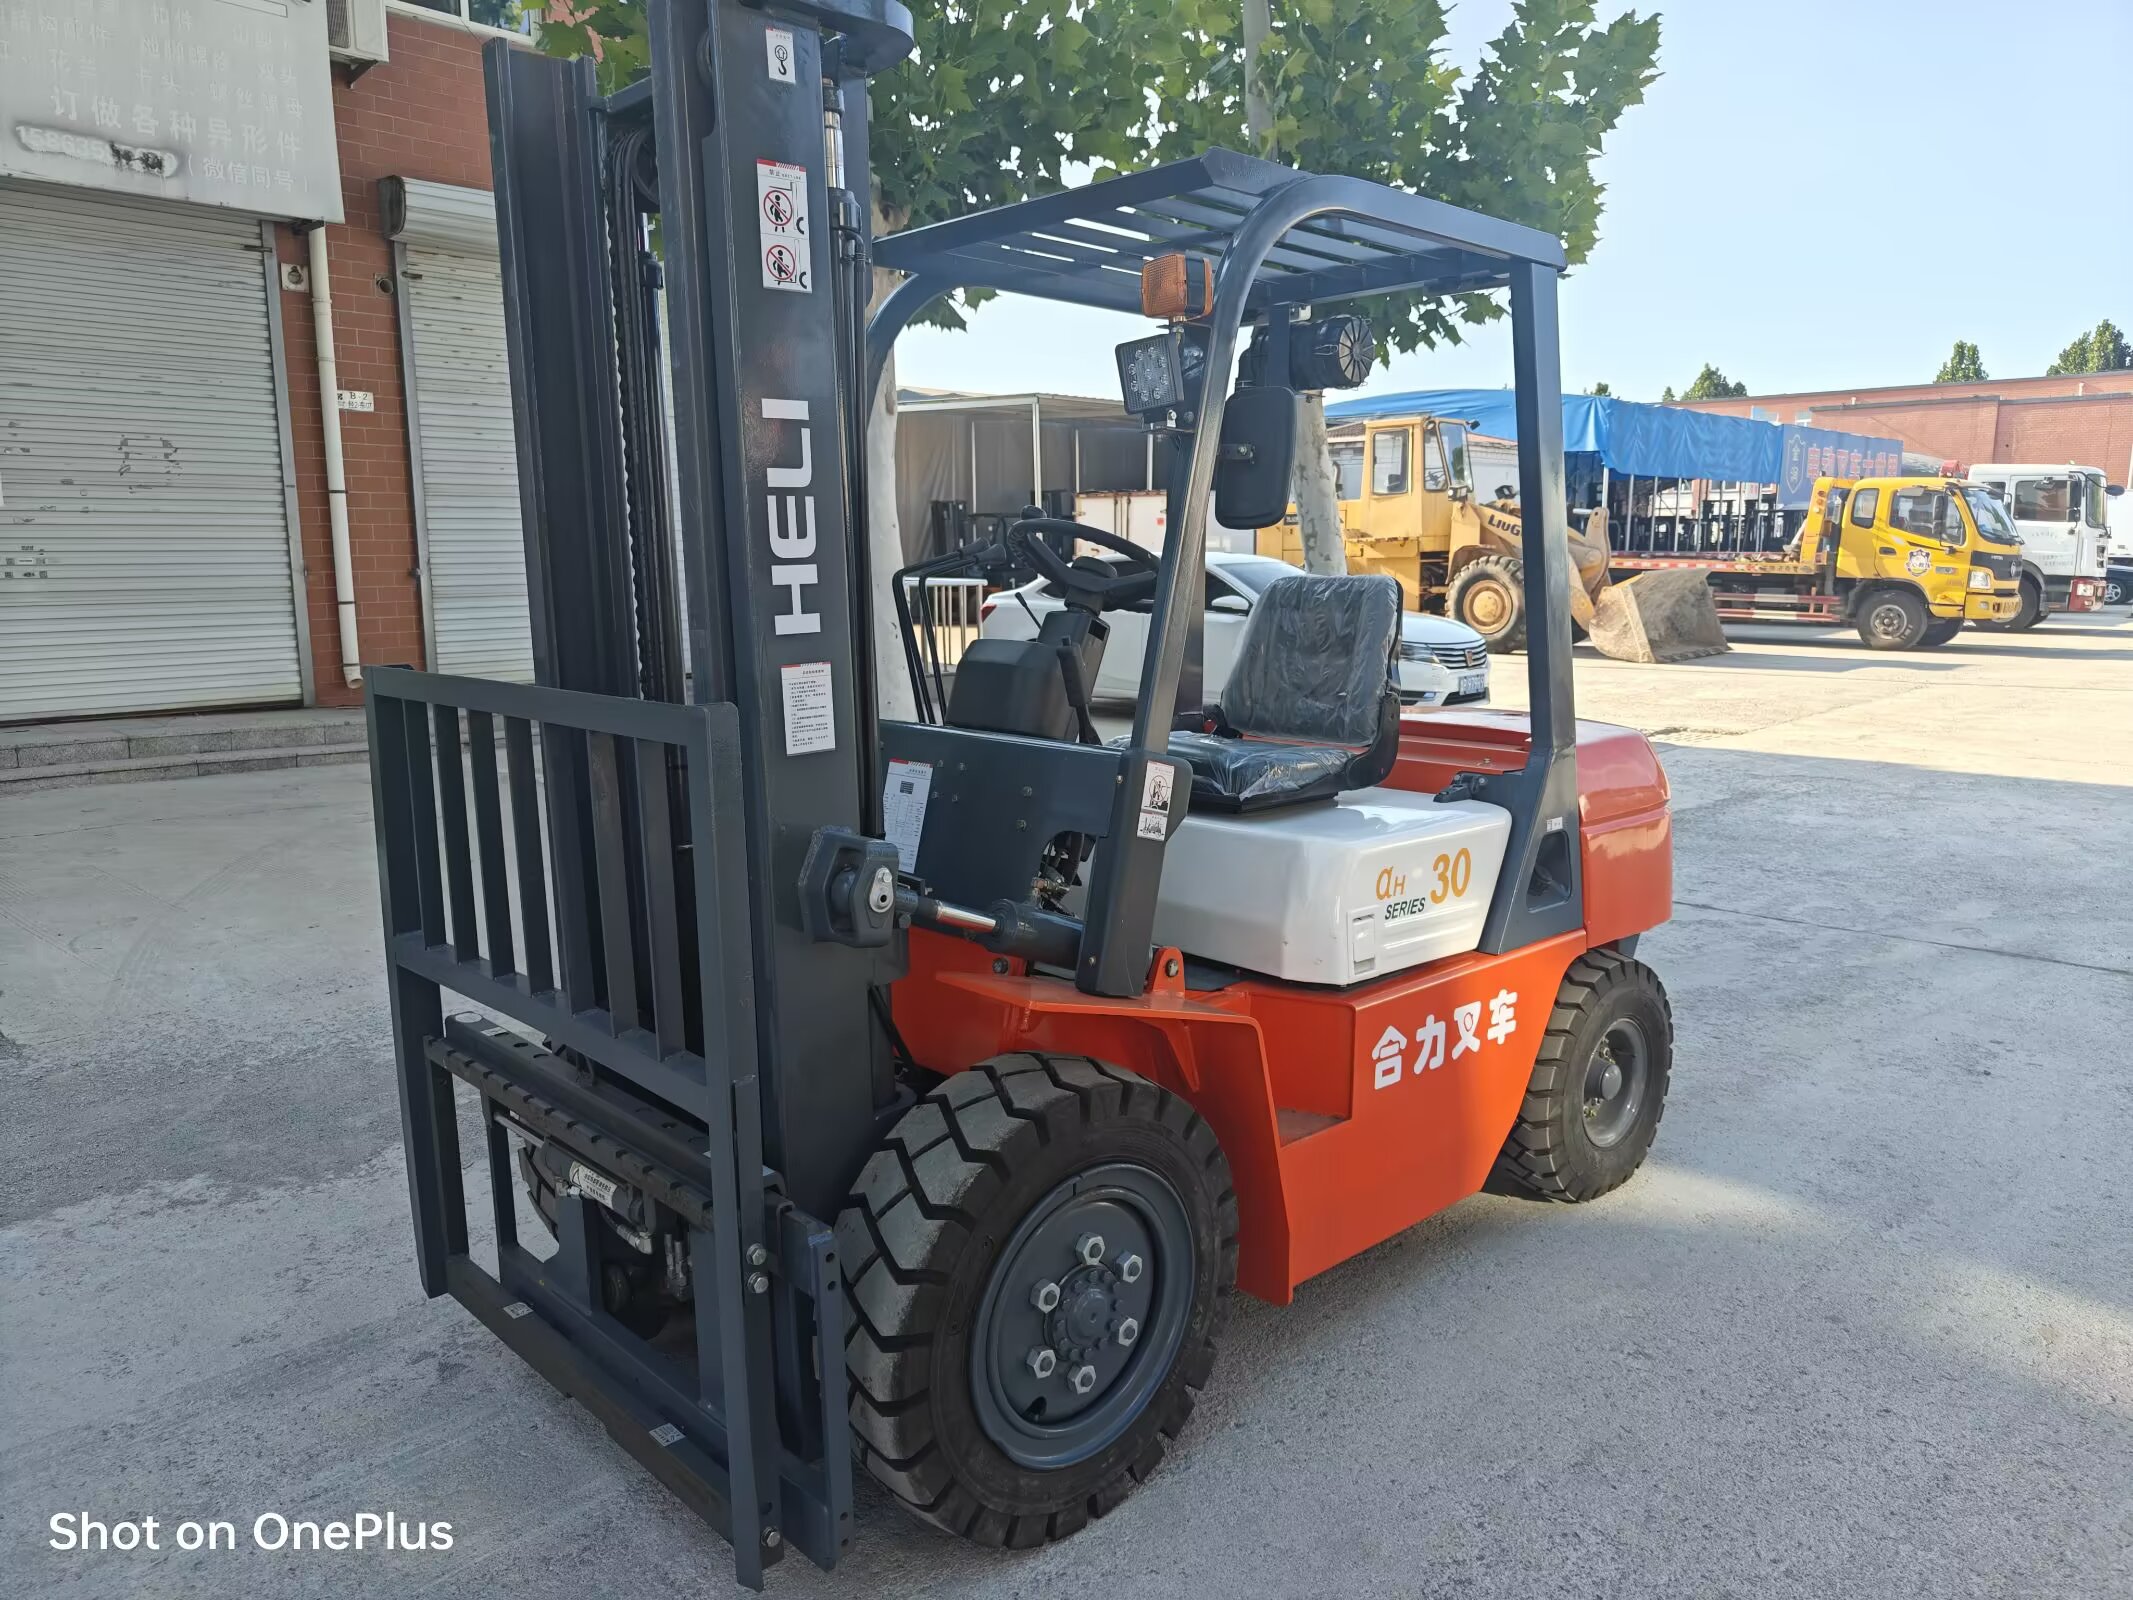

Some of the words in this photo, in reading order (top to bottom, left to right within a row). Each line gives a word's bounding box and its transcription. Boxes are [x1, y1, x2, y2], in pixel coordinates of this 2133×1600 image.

[50, 86, 303, 164] 订做各种异形件
[760, 397, 822, 637] HELI
[1384, 896, 1426, 921] SERIES
[1429, 846, 1472, 905] 30
[1371, 987, 1519, 1091] 合力叉车
